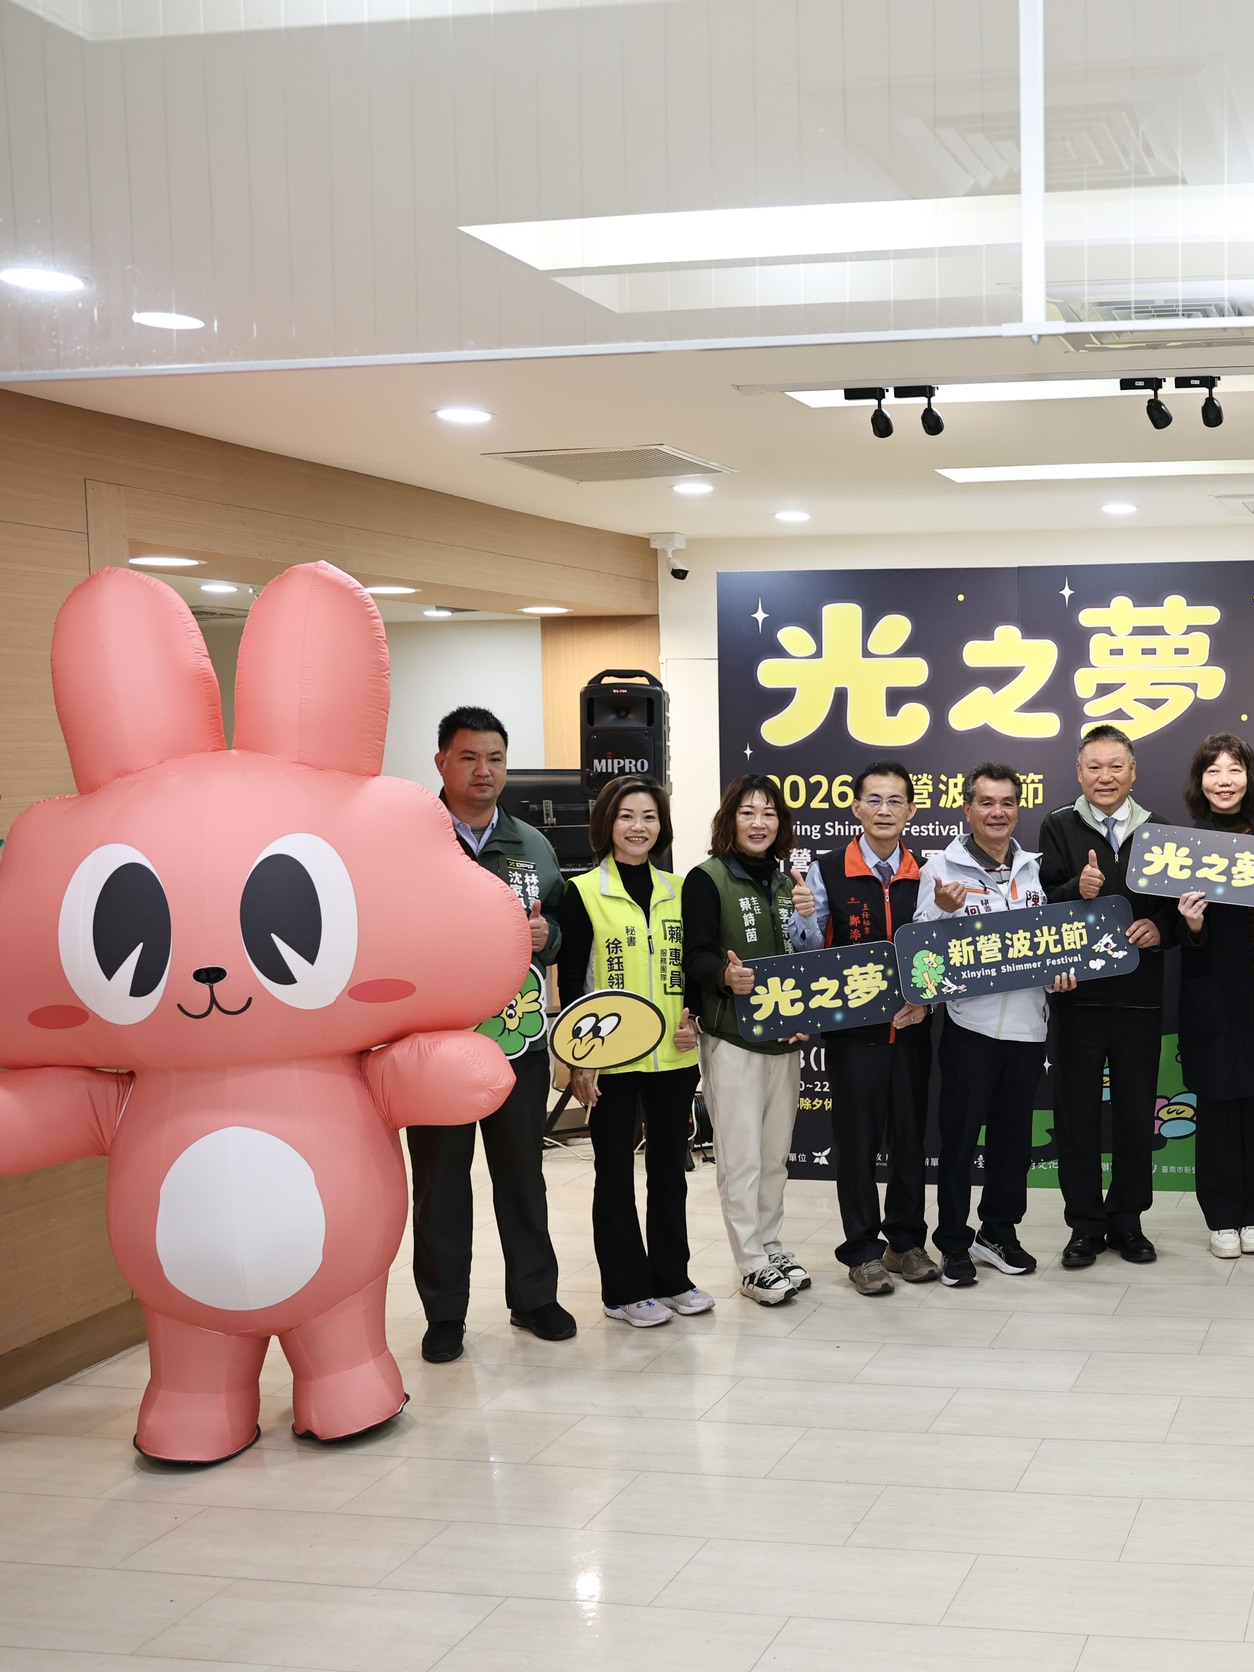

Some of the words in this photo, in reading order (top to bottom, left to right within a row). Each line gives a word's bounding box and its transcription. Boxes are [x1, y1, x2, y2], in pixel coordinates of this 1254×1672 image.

[757, 595, 1227, 747] 光之夢
[902, 820, 964, 837] Festival
[738, 897, 758, 943] 蔡詩茵
[750, 896, 762, 915] 主任
[965, 905, 981, 916] 何
[625, 925, 637, 947] 秘書
[849, 914, 862, 944] 鄭添
[947, 921, 1088, 967] 新營波光節
[668, 925, 683, 989] 賴惠員
[961, 966, 997, 979] Xinying
[1001, 960, 1042, 973] Shimmer
[1046, 953, 1082, 966] Festival
[750, 962, 888, 1021] 光之夢
